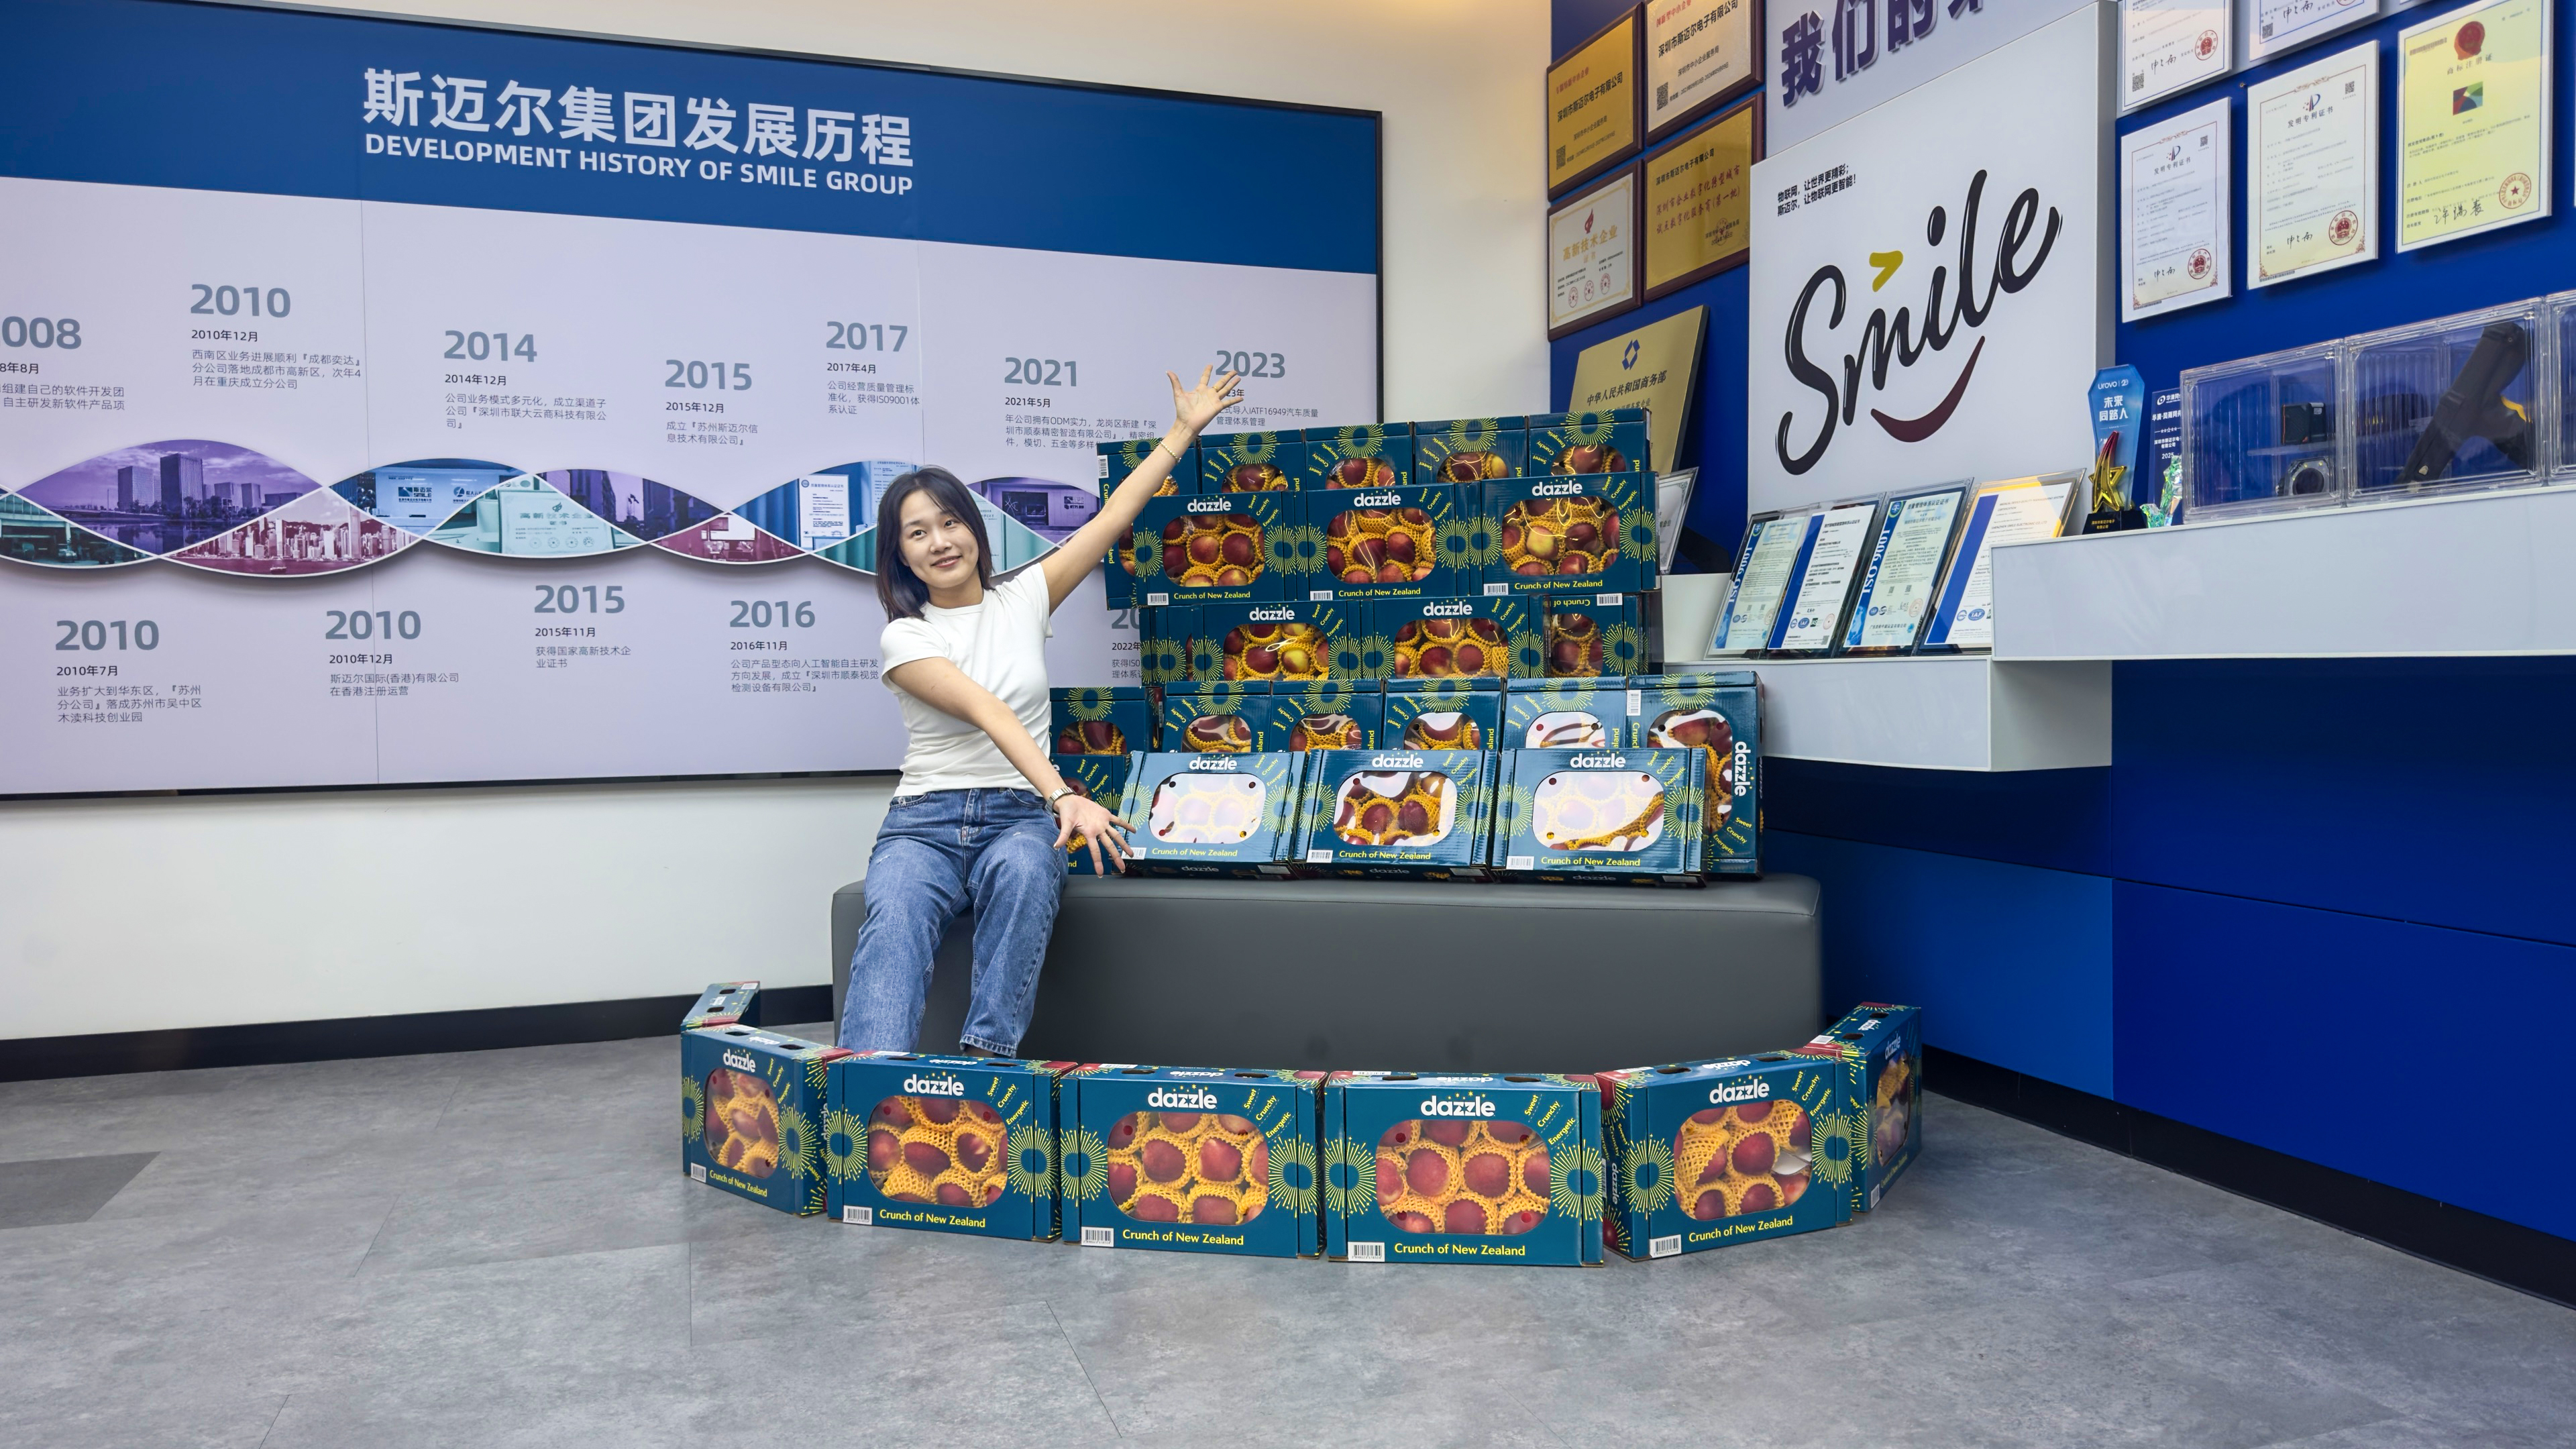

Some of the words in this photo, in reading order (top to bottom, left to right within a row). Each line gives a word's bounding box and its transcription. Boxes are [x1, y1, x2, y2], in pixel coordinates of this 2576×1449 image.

[1658, 0, 1738, 58] 深圳市斯迈尔电子有限公司
[1782, 0, 1984, 107] 我们的
[1558, 72, 1623, 123] 深圳市斯迈尔电子有限公司
[364, 68, 913, 167] 斯迈尔集团发展历程
[2288, 106, 2333, 128] 发明专利证书
[366, 133, 570, 169] DEVELOPMENT
[579, 150, 692, 178] HISTORY
[700, 160, 732, 181] OF
[740, 163, 817, 188] SMILE
[826, 170, 913, 195] GROUP
[2154, 156, 2191, 176] 发明专利证书
[1563, 225, 1617, 261] 高新技术企业
[190, 284, 290, 317] 2010
[1776, 169, 2063, 475] Smile
[0, 315, 82, 350] 008
[191, 329, 258, 343] 2010年12月
[826, 321, 908, 352] 2017
[443, 330, 537, 362] 2014
[192, 350, 361, 366] 西南区业务进展顺利『成都奕达』
[1215, 350, 1285, 378] 2023
[192, 362, 361, 378] 分公司落地成都市高新区，次年4
[665, 359, 753, 391] 2015
[826, 362, 876, 374] 2017年4月
[1004, 357, 1077, 387] 2021
[193, 376, 298, 389] 月在重庆成立分公司
[445, 374, 507, 386] 2014年12月
[827, 380, 914, 394] 公司经营质量管理标
[1587, 370, 1667, 406] 中华人民共和国商务部
[2098, 382, 2117, 390] urovo
[0, 383, 125, 398] 组建自己的软件开发团
[445, 392, 606, 409] 公司业务模式多元化，成立渠道子
[665, 402, 724, 414] 2015年12月
[828, 393, 920, 406] 准化，获得ISO9001体
[1005, 396, 1051, 409] 2021年5月
[2104, 395, 2123, 409] 未来
[445, 405, 606, 421] 公司『深圳市联大云商科技有限公
[828, 405, 857, 415] 系认证
[2099, 409, 2129, 422] 同路人
[666, 421, 758, 435] 成立『苏州斯迈尔信
[1216, 417, 1265, 426] 管理体系管理
[667, 433, 744, 446] 息技术有限公司』
[1532, 480, 1582, 496] dazzle
[1602, 476, 1612, 491] Sweet
[1611, 479, 1627, 498] Crunchy
[1187, 498, 1232, 513] dazzle
[1354, 492, 1401, 508] dazzle
[1618, 490, 1638, 511] Energetic
[1862, 566, 1878, 594] ISO
[1874, 529, 1890, 564] 9001
[1729, 579, 1741, 604] ISO
[1737, 546, 1752, 578] 9001
[1515, 582, 1542, 590] Crunch
[1554, 580, 1571, 588] New
[1572, 580, 1603, 588] Zealand
[534, 585, 625, 614] 2015
[730, 600, 816, 628] 2016
[1249, 606, 1295, 621] dazzle
[1423, 601, 1473, 616] dazzle
[325, 610, 421, 640] 2010
[535, 627, 596, 638] 2015年11月
[55, 619, 160, 651] 2010
[535, 645, 631, 657] 获得国家高新技术企
[731, 641, 788, 651] 2016年11月
[1112, 641, 1140, 651] 2022年
[329, 653, 393, 665] 2010年12月
[536, 658, 568, 668] 业证书
[731, 658, 879, 669] 公司产品型态向人工智能自主研发
[57, 665, 118, 677] 2010年7月
[330, 672, 460, 685] 斯迈尔国际(香港)有限公司
[731, 670, 879, 682] 方向发展，成立『深圳市顺泰视觉
[57, 684, 201, 697] 业务扩大到华东区，『苏州
[330, 686, 409, 697] 在香港注册运营
[731, 682, 818, 693] 检测设备有限公司』
[57, 698, 202, 710] 分公司』落成苏州市吴中区
[57, 712, 143, 723] 木渎科技创业园
[1189, 756, 1237, 771] dazzle
[1372, 754, 1424, 768] dazzle
[1570, 753, 1626, 768] dazzle
[1648, 751, 1659, 766] Sweet
[1656, 755, 1675, 775] Crunchy
[1664, 766, 1686, 787] Energetic
[1734, 741, 1751, 796] dazzle
[1338, 850, 1367, 860] Crunch
[1370, 851, 1378, 860] of
[1380, 851, 1398, 860] New
[1400, 851, 1432, 861] Zealand
[1541, 857, 1572, 866] Crunch
[1574, 857, 1583, 866] of
[1585, 857, 1605, 867] New
[1607, 858, 1641, 867] Zealand
[722, 1048, 756, 1073] dazzle
[904, 1074, 965, 1096] dazzle
[987, 1077, 999, 1097] Sweet
[1792, 1070, 1804, 1092] Sweet
[1801, 1074, 1820, 1102] Crunchy
[998, 1083, 1017, 1108] Crunchy
[1148, 1087, 1218, 1109] dazzle
[1244, 1088, 1257, 1110] Sweet
[1709, 1079, 1770, 1104] dazzle
[1255, 1095, 1277, 1121] Crunchy
[1421, 1095, 1496, 1117] dazzle
[1524, 1094, 1538, 1116] Sweet
[1810, 1087, 1831, 1118] Energetic
[1006, 1099, 1029, 1126] Energetic
[1537, 1100, 1560, 1128] Crunchy
[1265, 1112, 1291, 1139] Energetic
[1548, 1117, 1576, 1146] Energetic
[710, 1170, 728, 1183] Crunch
[729, 1176, 735, 1185] of
[735, 1178, 747, 1190] New
[748, 1182, 767, 1197] Zealand
[879, 1208, 912, 1222] Crunch
[915, 1211, 925, 1224] of
[927, 1212, 948, 1225] New
[950, 1214, 986, 1228] Zealand
[1122, 1228, 1160, 1242] Crunch
[1163, 1230, 1174, 1242] of
[1177, 1231, 1200, 1244] New
[1203, 1232, 1244, 1246] Zealand
[1688, 1226, 1721, 1243] Crunch
[1723, 1224, 1733, 1238] of
[1735, 1220, 1756, 1236] New
[1758, 1215, 1793, 1233] Zealand
[1394, 1242, 1435, 1254] Crunch
[1438, 1243, 1450, 1255] of
[1453, 1243, 1479, 1256] New
[1481, 1244, 1526, 1256] Zealand
